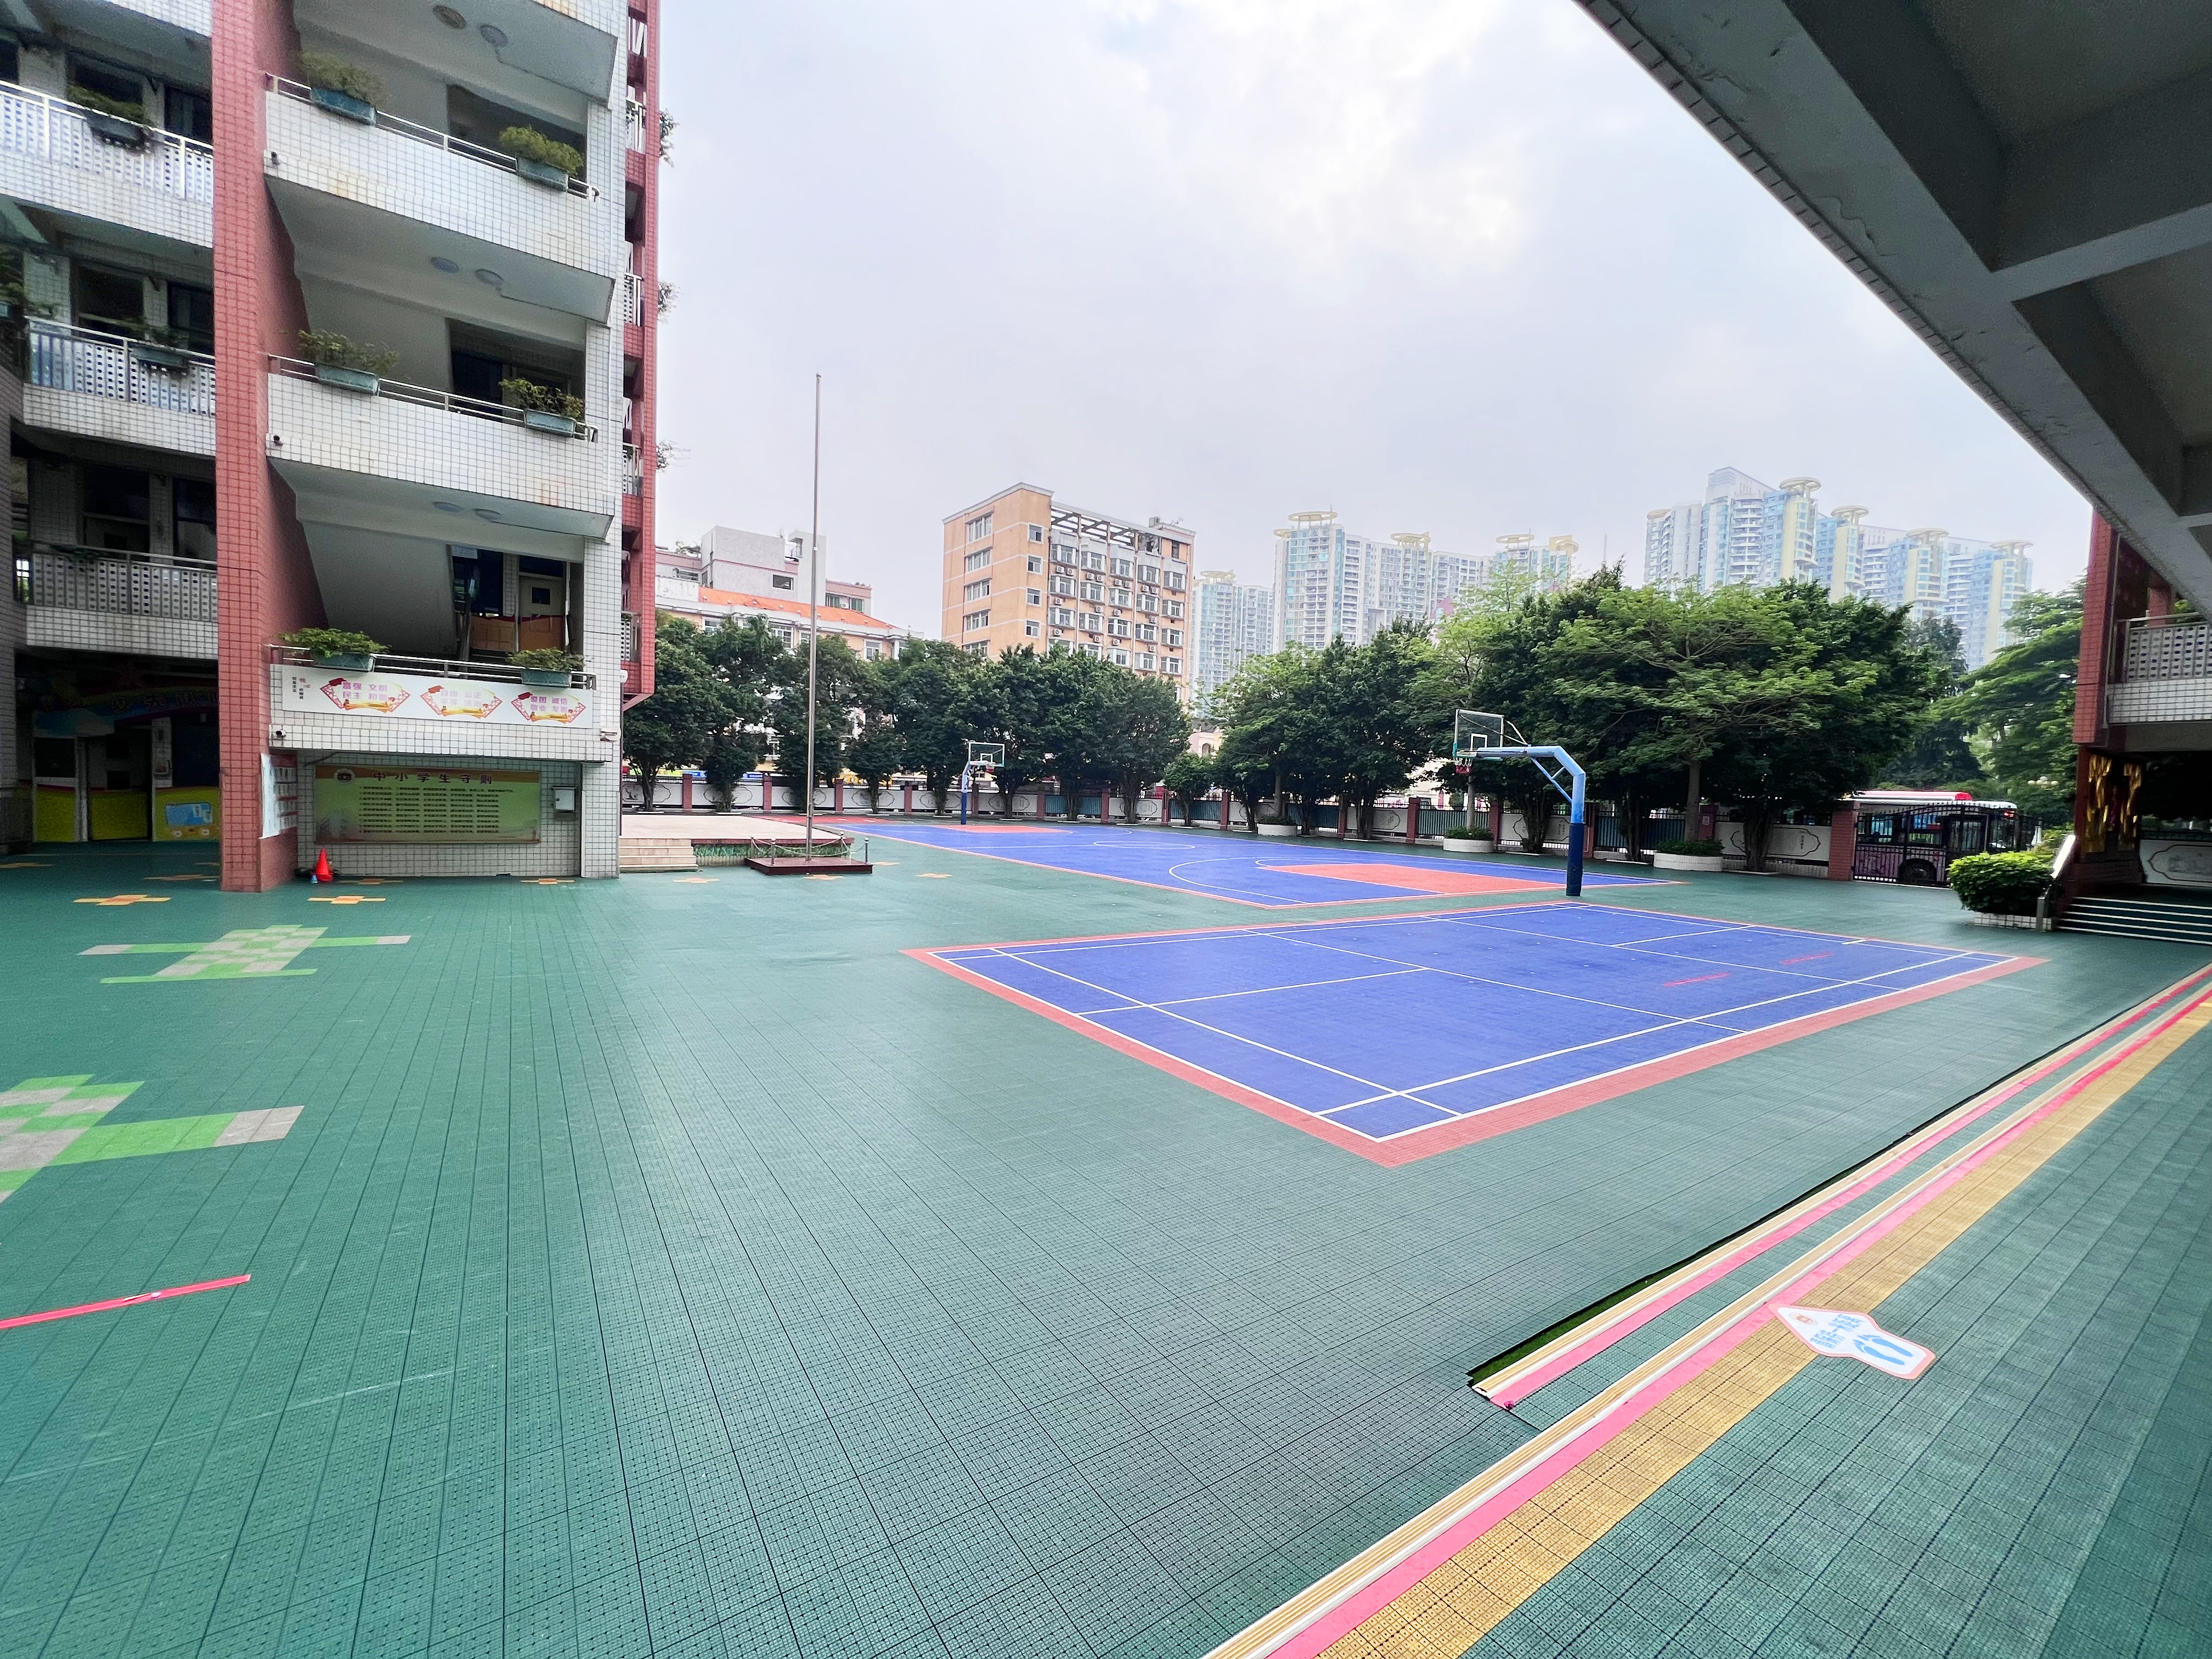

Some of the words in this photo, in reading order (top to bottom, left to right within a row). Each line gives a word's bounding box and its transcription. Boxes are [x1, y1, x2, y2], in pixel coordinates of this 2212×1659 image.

[343, 682, 362, 690] 富强
[343, 691, 362, 699] 民主
[369, 693, 387, 701] 和谐
[373, 771, 493, 785] 中小学生守则
